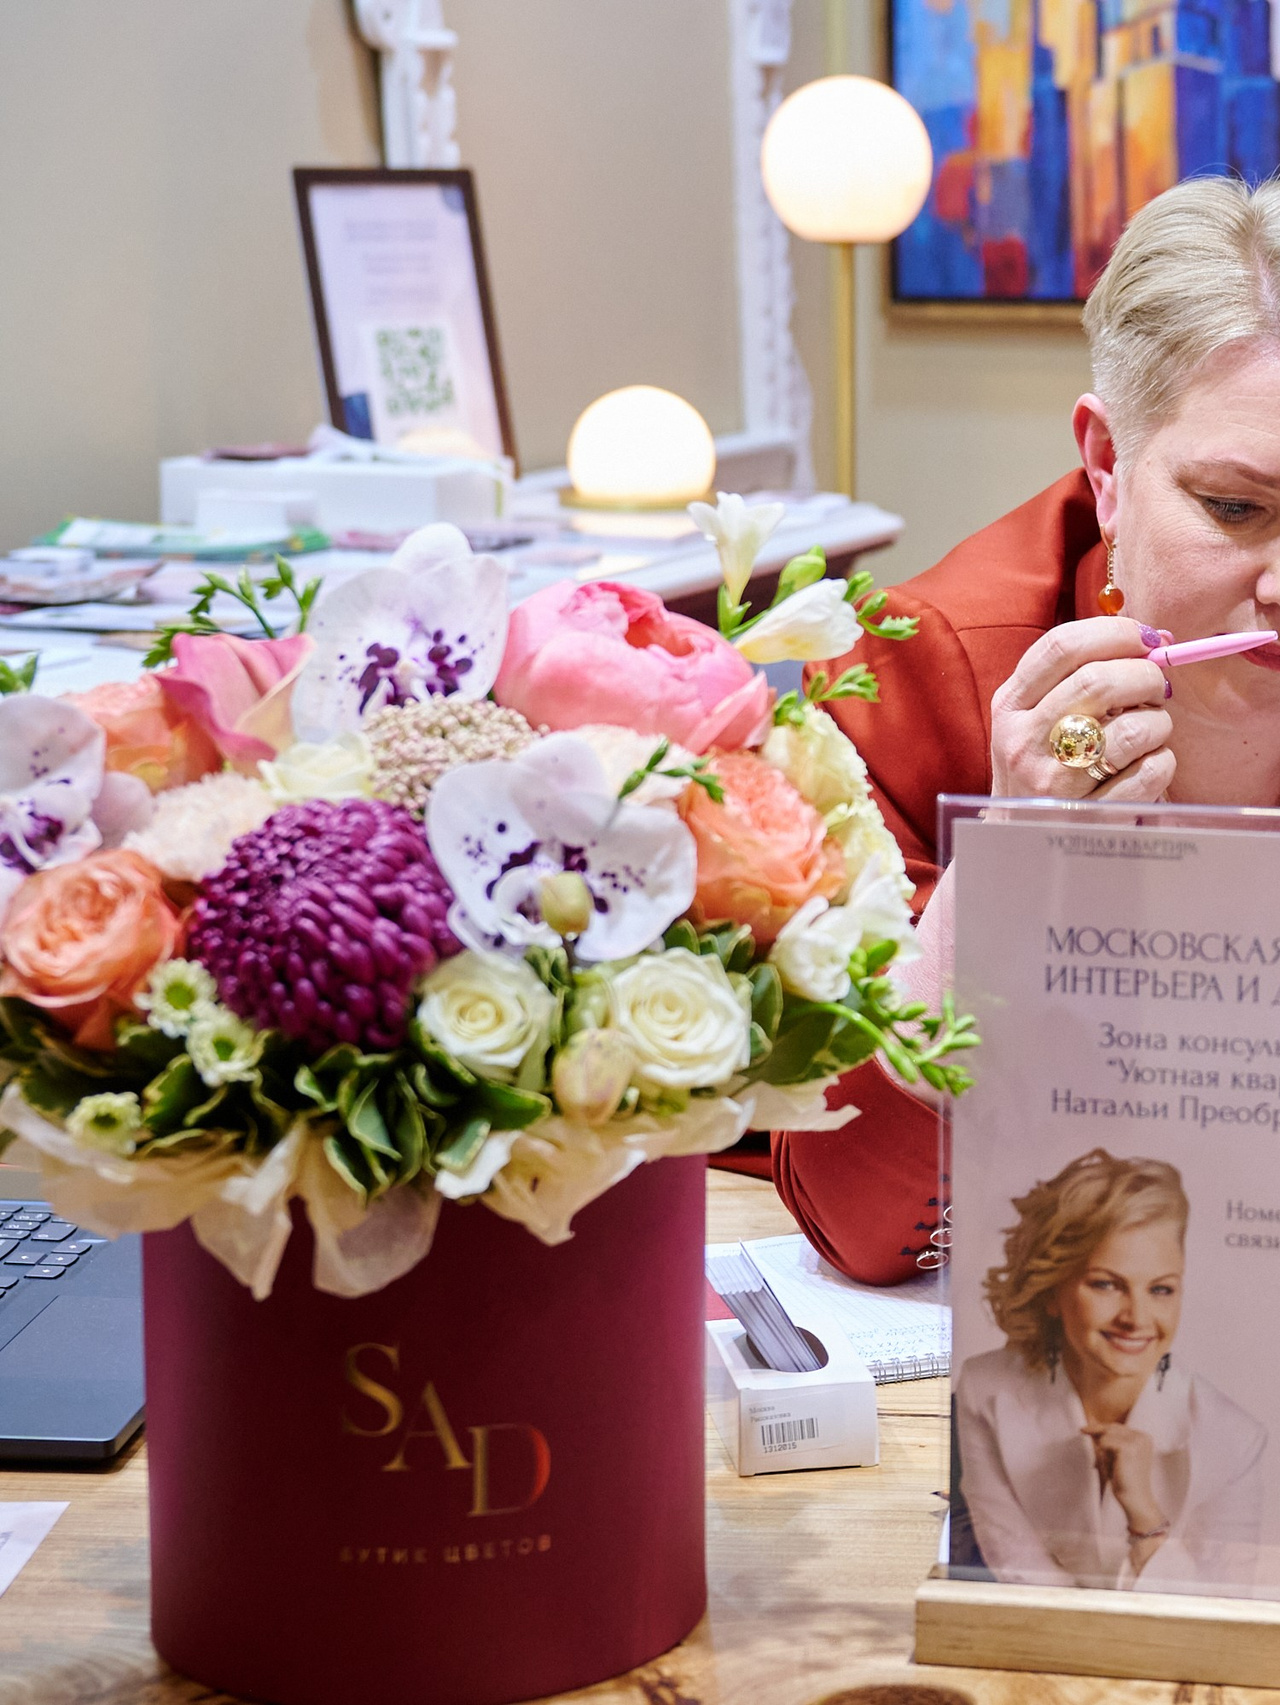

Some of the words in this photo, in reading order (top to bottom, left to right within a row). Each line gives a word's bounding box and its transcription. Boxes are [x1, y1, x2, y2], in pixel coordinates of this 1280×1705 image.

[1044, 965, 1223, 1001] ИНТЕРЬЕРА
[1236, 976, 1261, 1003] И
[1098, 1022, 1168, 1051] Зона
[1050, 1089, 1169, 1120] Натальи
[343, 1342, 551, 1518] SAD
[764, 1442, 797, 1453] 1312015
